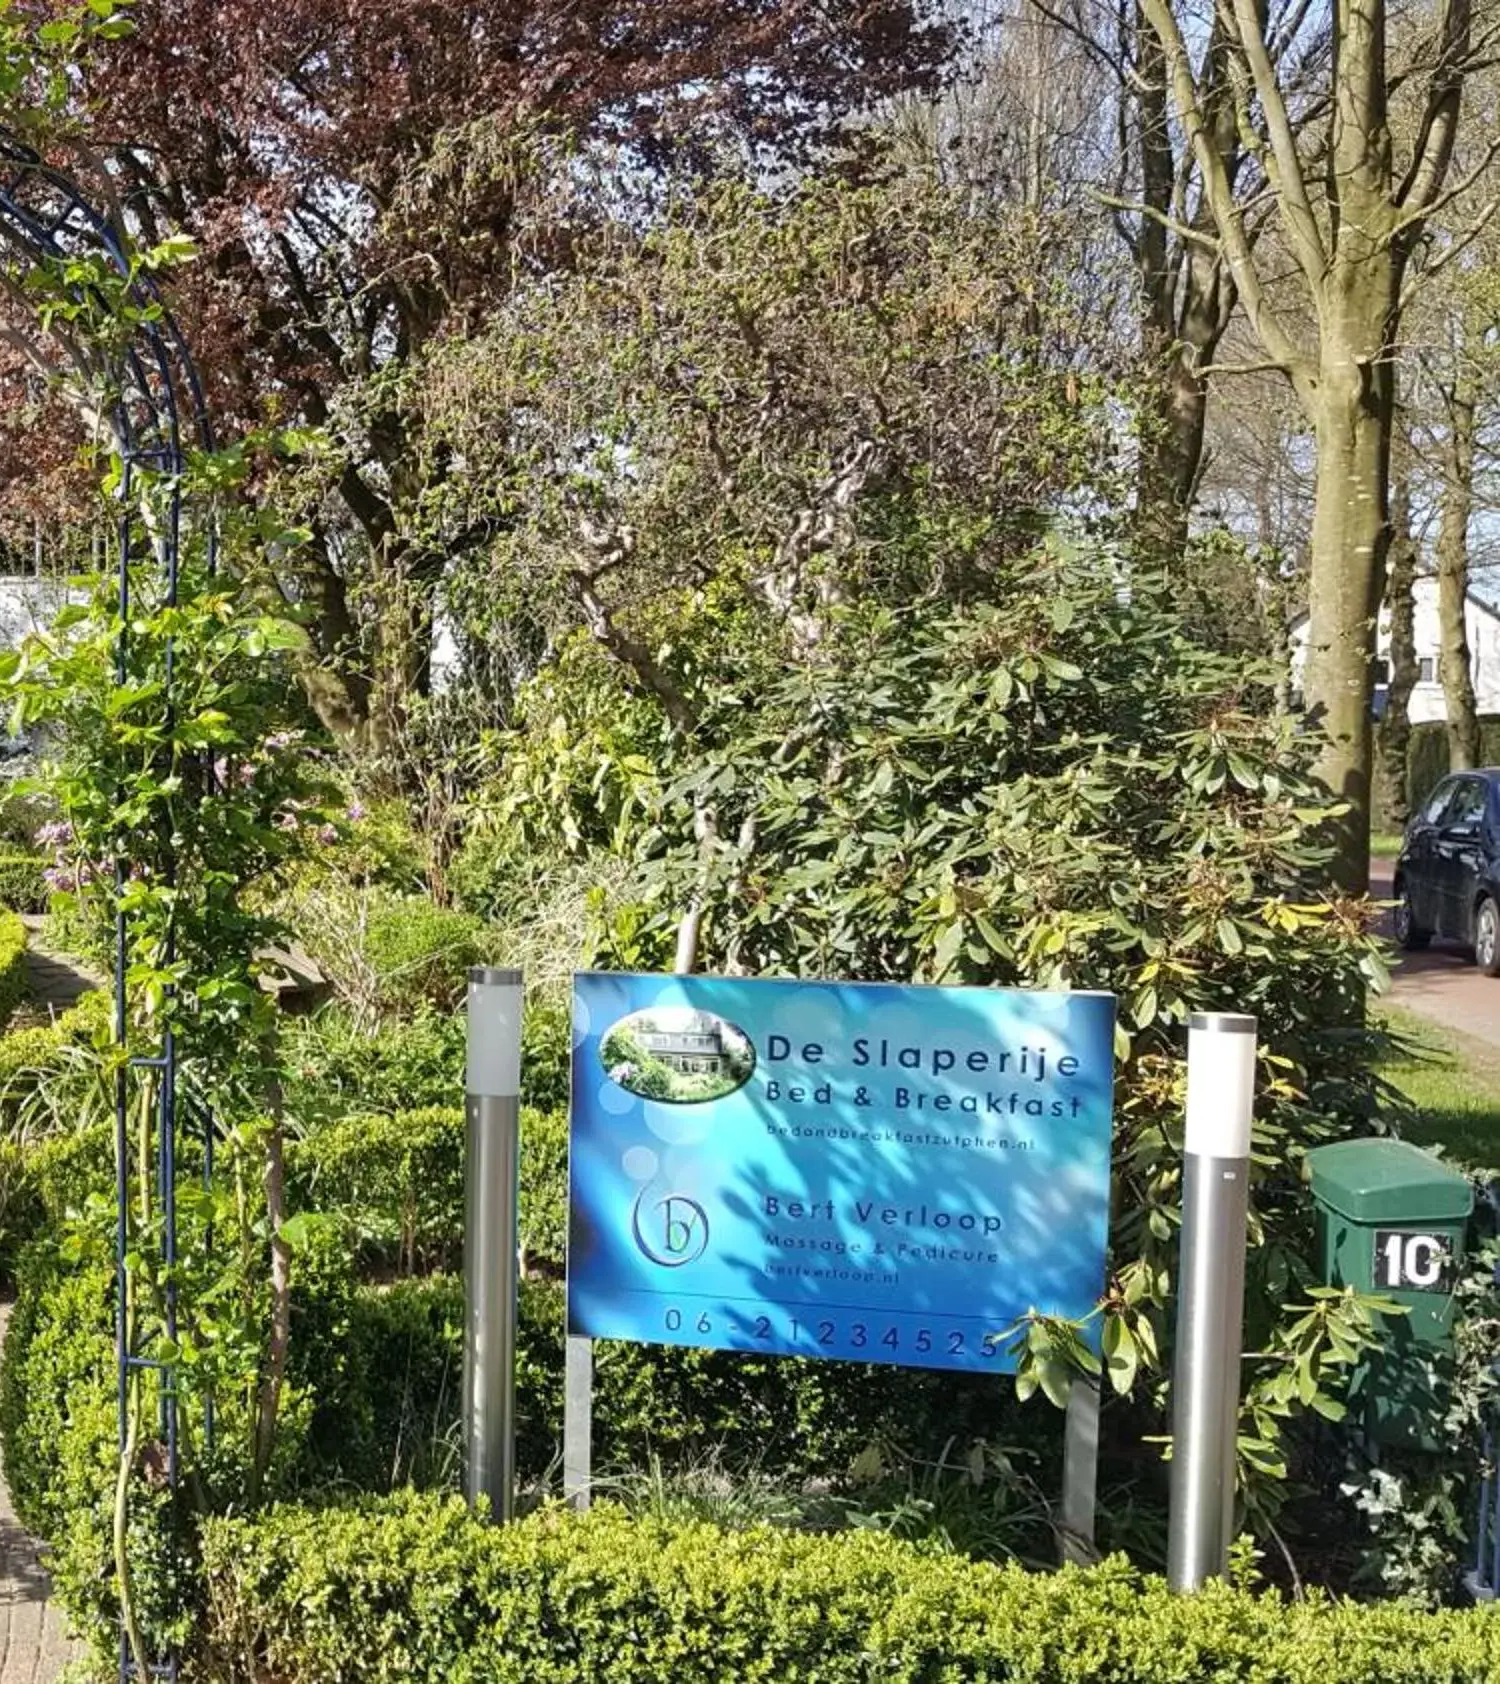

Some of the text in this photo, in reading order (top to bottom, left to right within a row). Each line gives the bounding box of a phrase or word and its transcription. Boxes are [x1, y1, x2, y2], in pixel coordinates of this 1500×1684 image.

[767, 1035, 1080, 1082] De Slaperije
[766, 1081, 1083, 1118] Bed & Breakfast
[766, 1123, 1037, 1150] bedandbreakfastzutphen.nl
[765, 1196, 1002, 1236] Bert Verloop
[765, 1233, 999, 1264] Massage & Pedicure
[1383, 1234, 1441, 1287] 10
